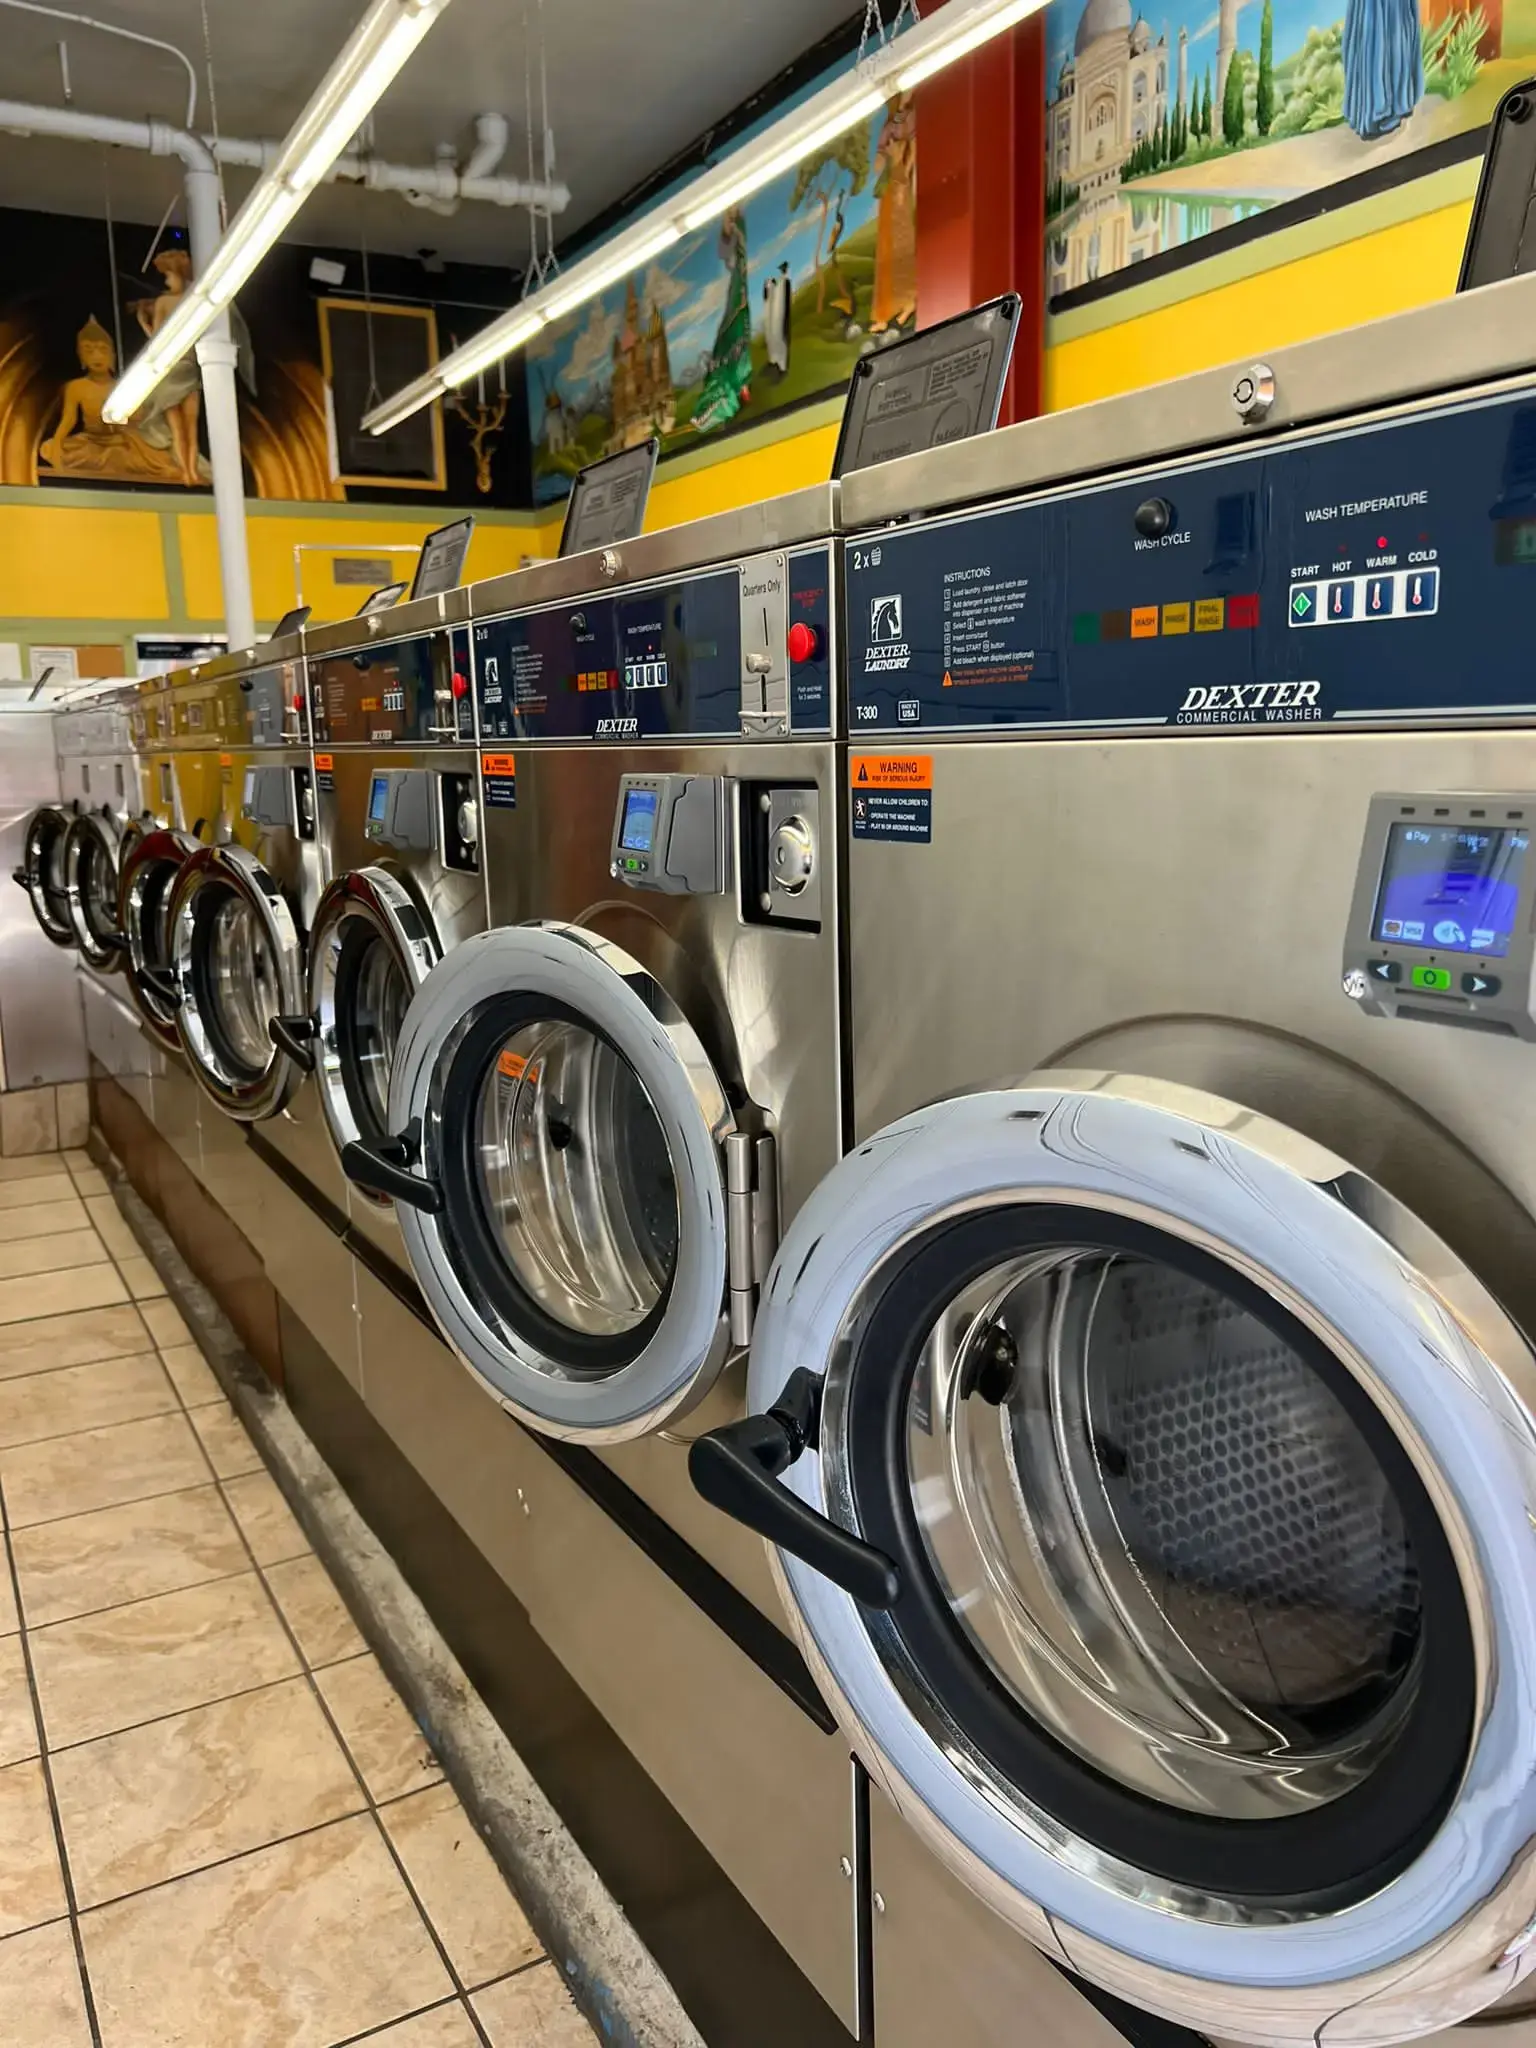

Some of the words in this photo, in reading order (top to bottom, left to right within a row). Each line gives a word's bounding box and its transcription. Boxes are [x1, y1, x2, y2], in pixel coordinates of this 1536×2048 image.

[1305, 507, 1338, 522] WASH
[1340, 490, 1428, 516] TEMPERATURE
[1134, 539, 1160, 551] WASH
[1161, 531, 1191, 546] CYCLE
[854, 551, 861, 570] 2
[1290, 565, 1321, 578] START
[1332, 561, 1352, 572] HOT
[1365, 555, 1398, 569] WARM
[1407, 549, 1438, 563] COLD
[944, 566, 991, 583] INSTRUCTIONS
[743, 584, 767, 598] Quarters
[767, 578, 780, 595] Only
[995, 582, 1004, 590] and
[962, 598, 983, 608] detergent
[1198, 604, 1218, 613] FINAL
[952, 621, 966, 630] Select
[1135, 616, 1155, 626] WASH
[1198, 615, 1220, 625] RINSE
[865, 643, 909, 660] DEXTER
[864, 657, 910, 672] LAUNDRY
[1179, 680, 1321, 711] DEXTER
[856, 705, 878, 720] T-300
[902, 709, 915, 718] USA
[1176, 710, 1257, 724] COMMERCIAL
[1265, 708, 1322, 721] WASHER
[595, 718, 638, 733] DEXTER
[879, 762, 917, 774] WARNING
[868, 797, 882, 805] NEVER
[883, 798, 898, 806] ALLOW
[898, 799, 920, 807] CHILDREN
[870, 812, 888, 820] OPERATE
[897, 813, 916, 821] MACHINE
[870, 822, 880, 830] PLAY
[892, 823, 909, 832] AROUND
[909, 825, 929, 833] MACHINE
[1414, 831, 1432, 844] Pay
